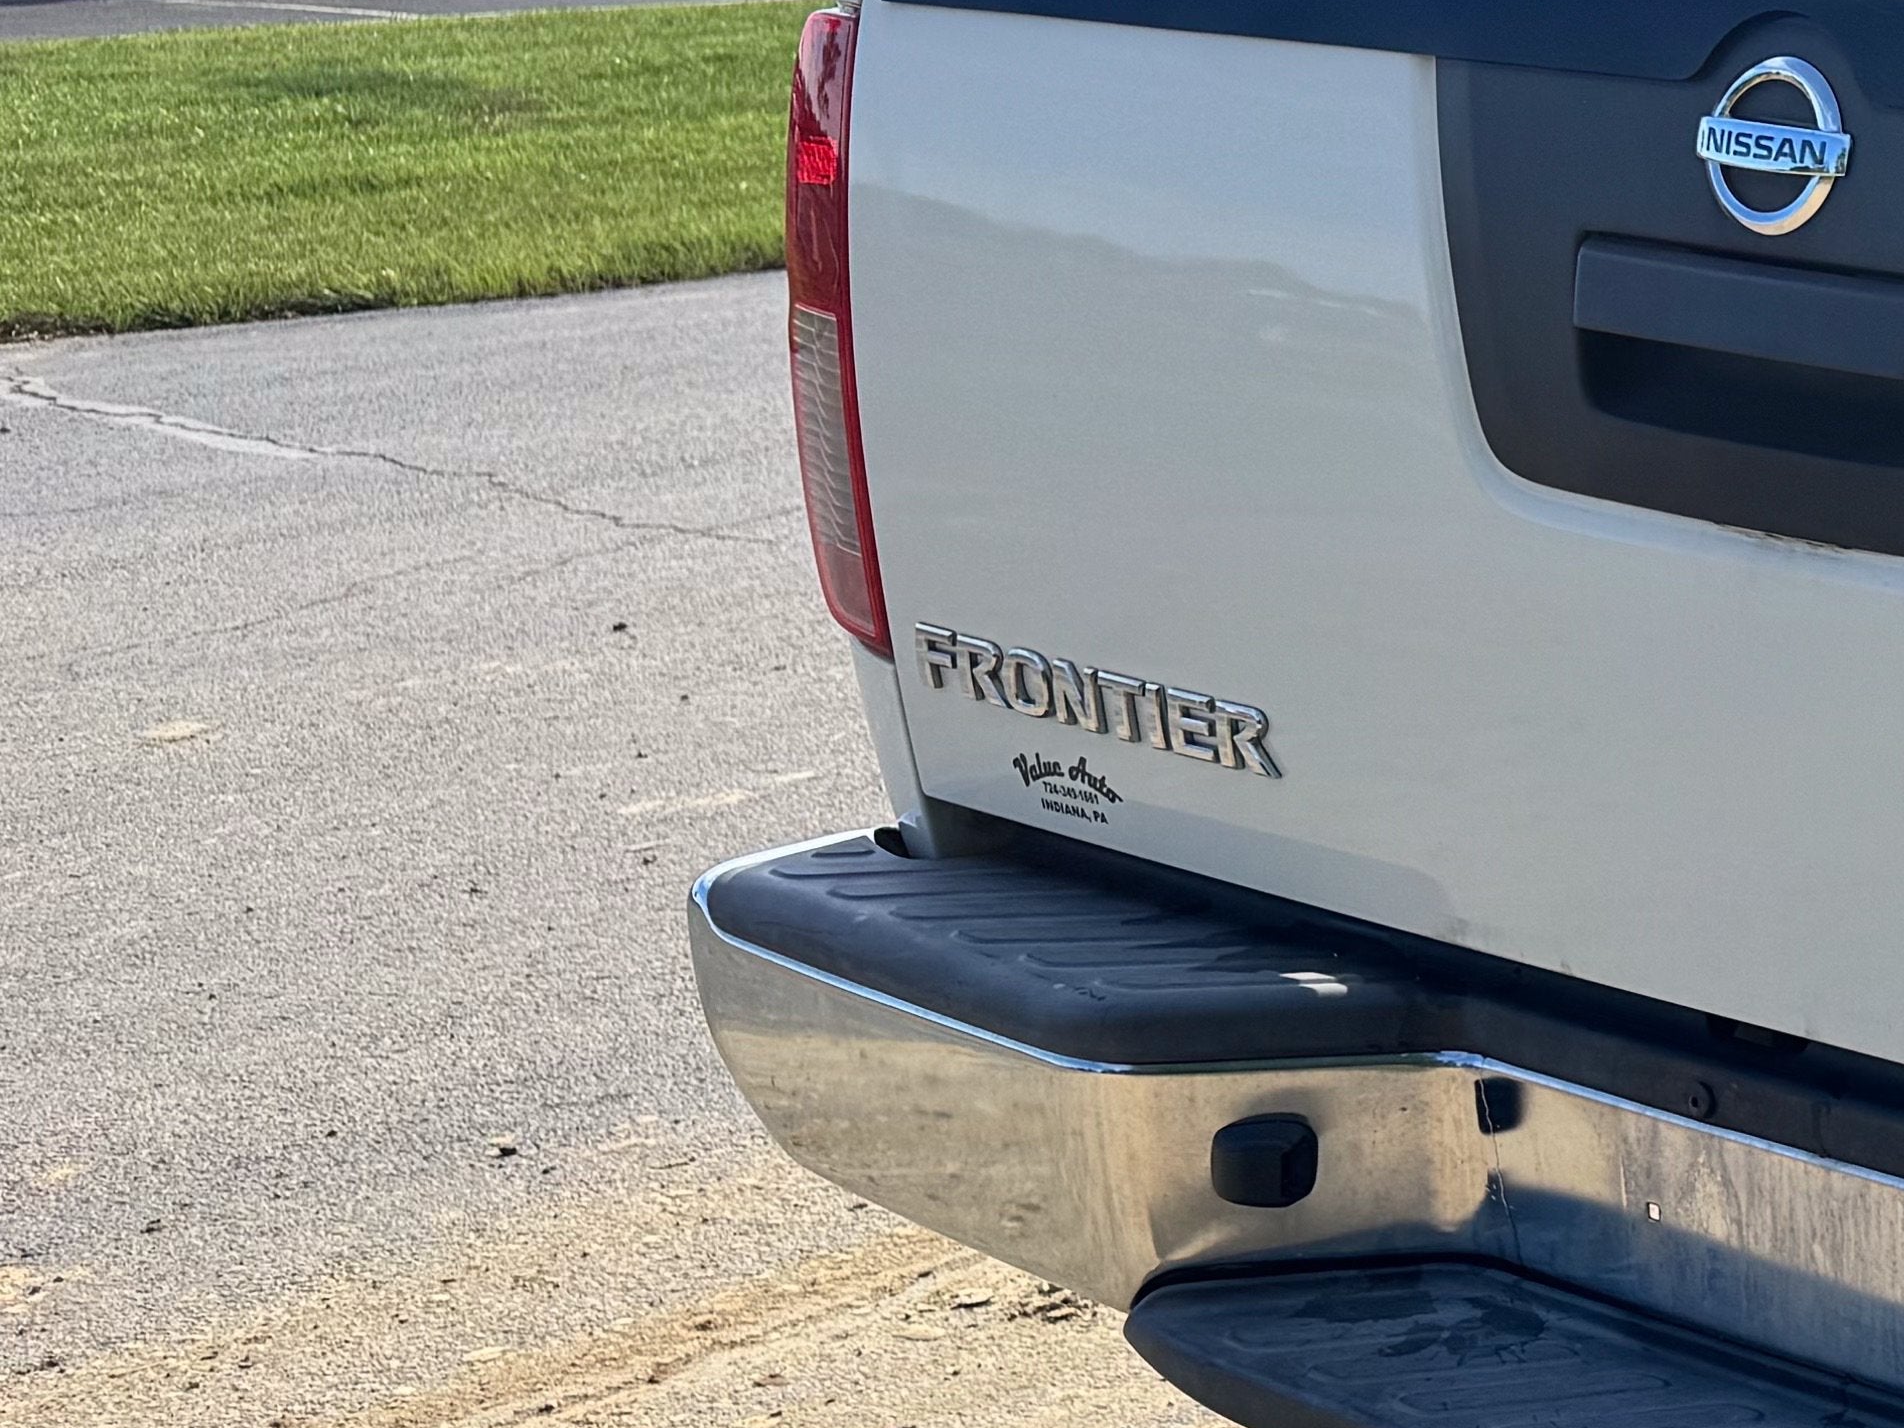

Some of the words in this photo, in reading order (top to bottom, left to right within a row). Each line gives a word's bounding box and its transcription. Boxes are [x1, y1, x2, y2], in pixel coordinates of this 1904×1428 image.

[1705, 126, 1828, 166] NISSAN
[914, 620, 1283, 780] FRONTIER
[1012, 751, 1065, 788] Value
[1067, 755, 1124, 804] Auto
[1040, 797, 1092, 823] INDIANA,
[1092, 809, 1109, 825] PA
